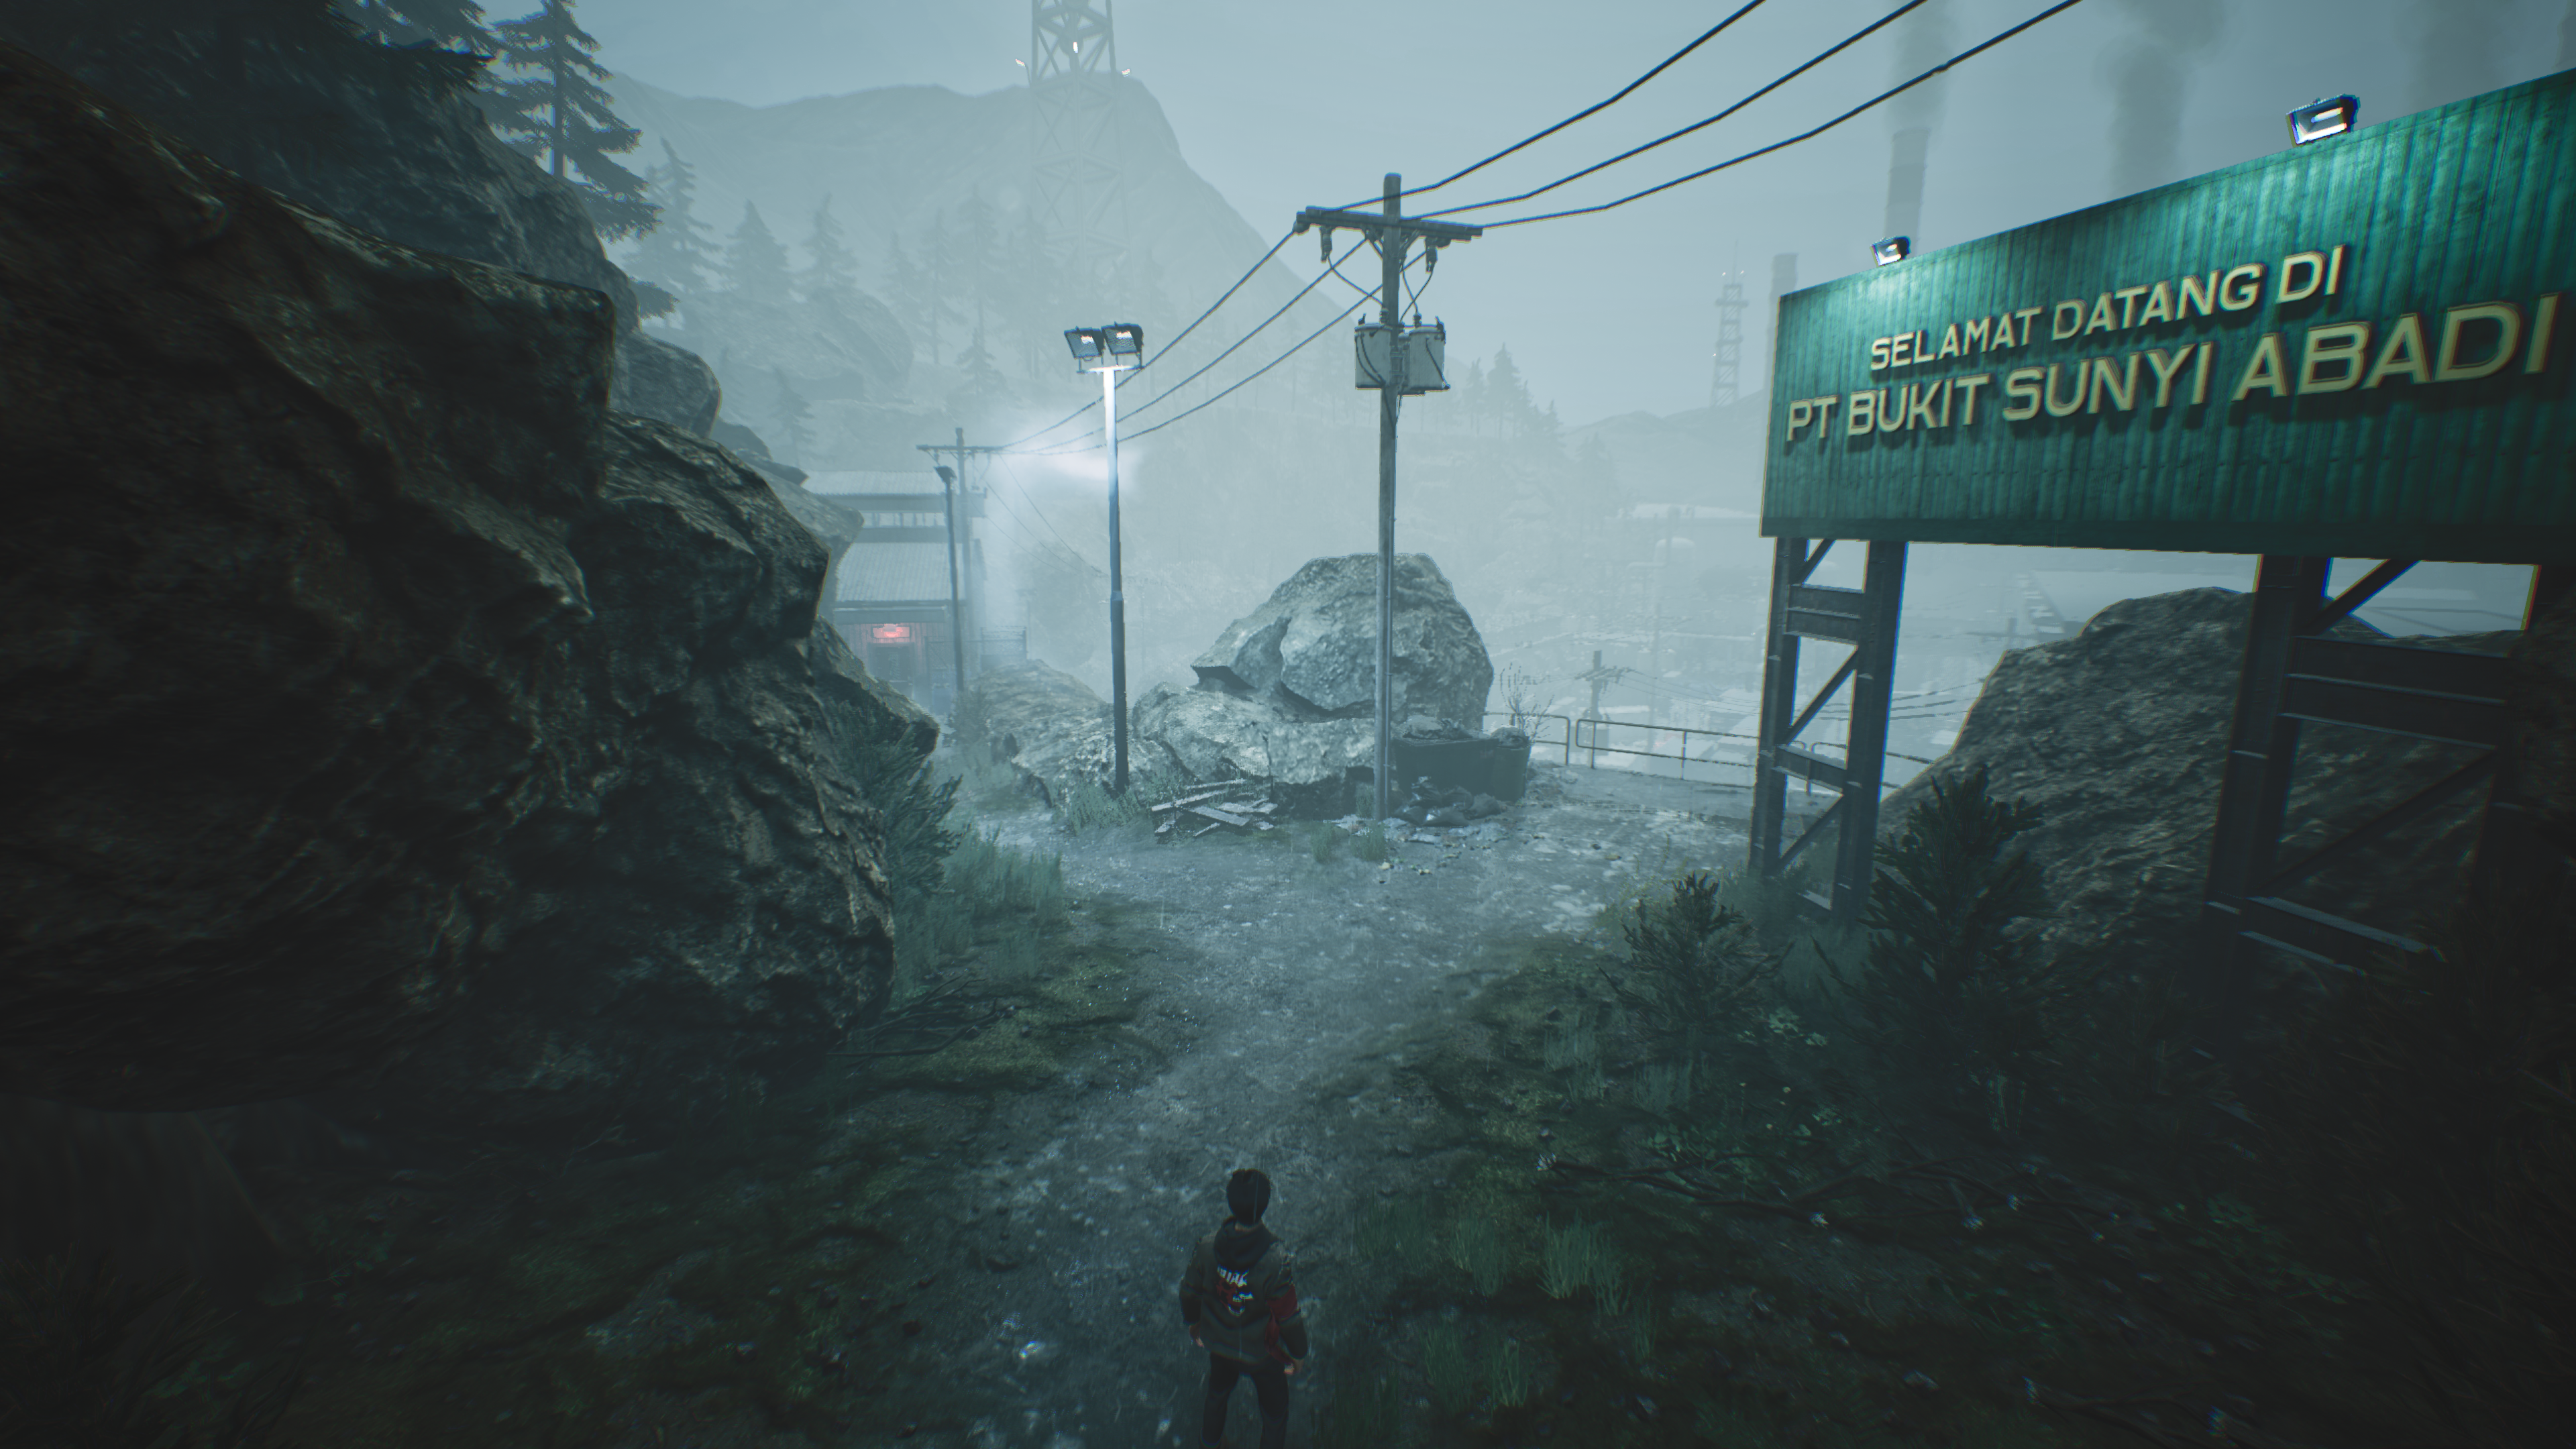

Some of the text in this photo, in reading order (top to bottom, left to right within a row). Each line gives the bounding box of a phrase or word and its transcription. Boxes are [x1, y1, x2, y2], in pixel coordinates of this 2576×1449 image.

[1786, 292, 2561, 441] PT BUKIT SUNYI ABADI
[1870, 244, 2345, 371] SELAMAT DATANG DI
